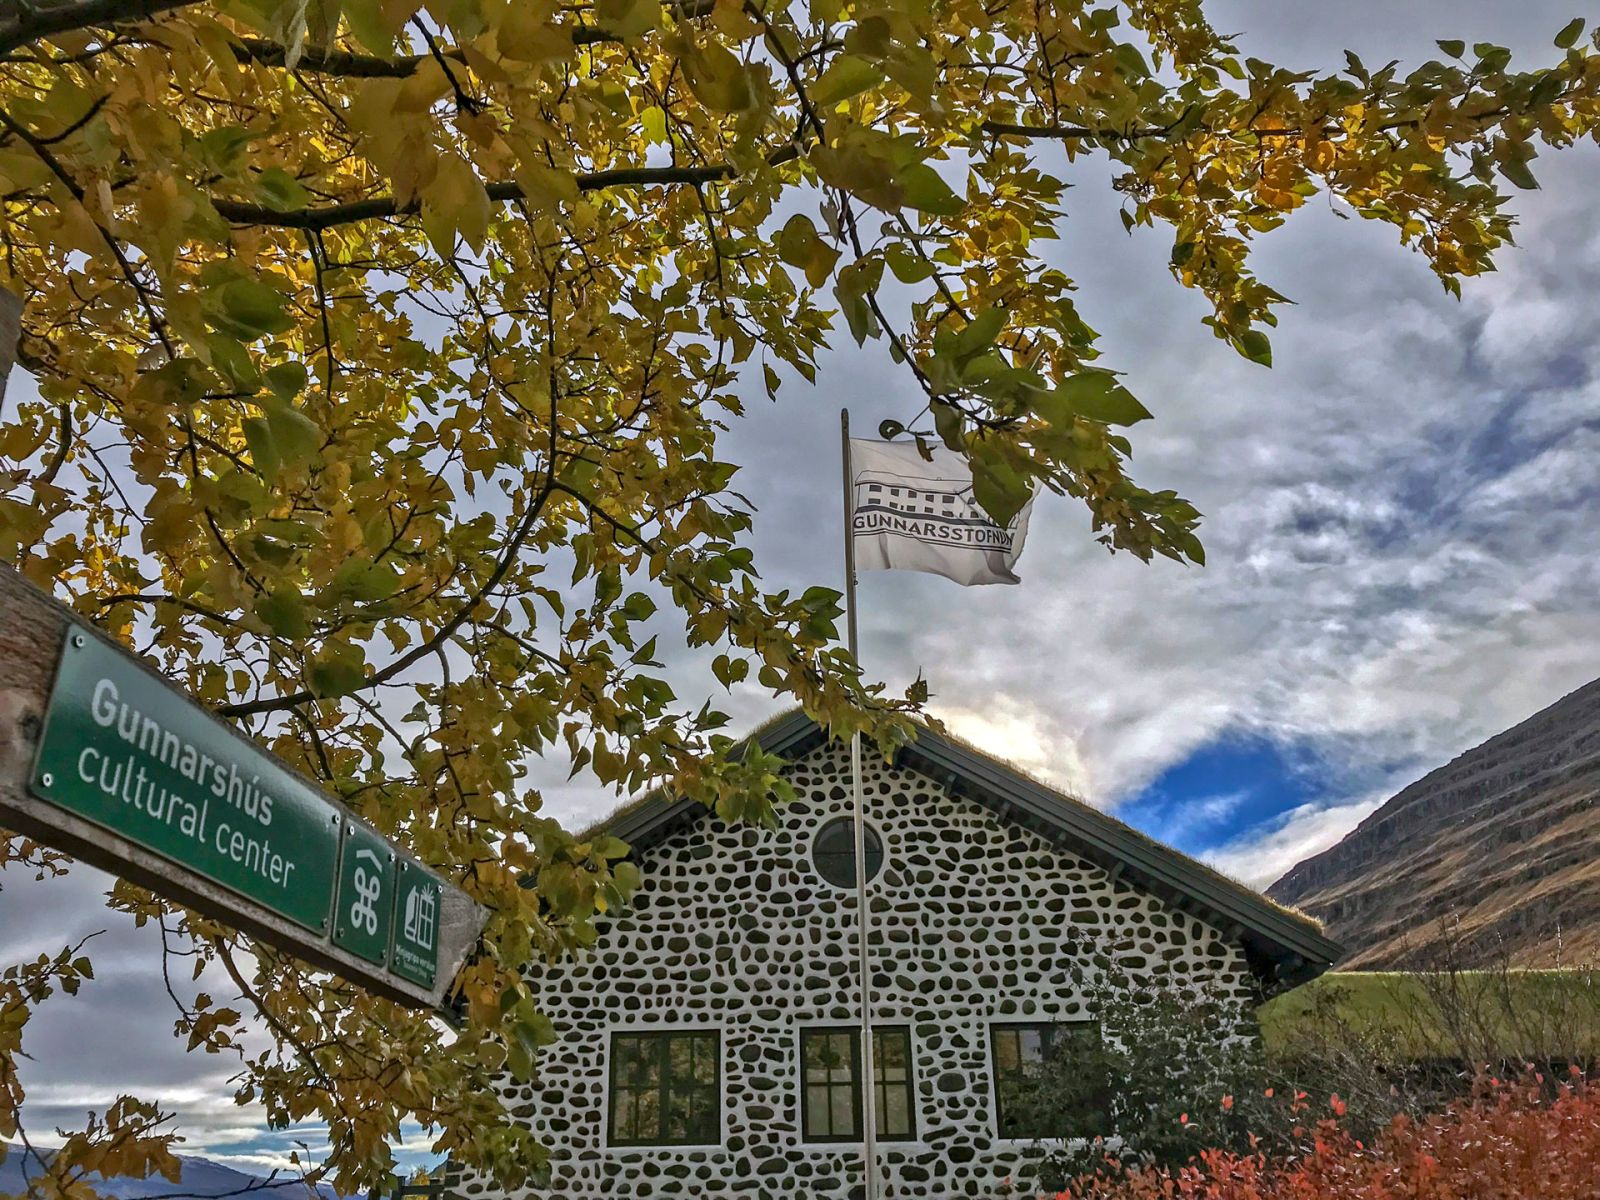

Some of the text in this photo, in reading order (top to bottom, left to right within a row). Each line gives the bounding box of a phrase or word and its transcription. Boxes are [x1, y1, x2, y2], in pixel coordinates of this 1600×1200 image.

[78, 747, 294, 888] cultural center
[92, 678, 273, 826] Gunnarshús
